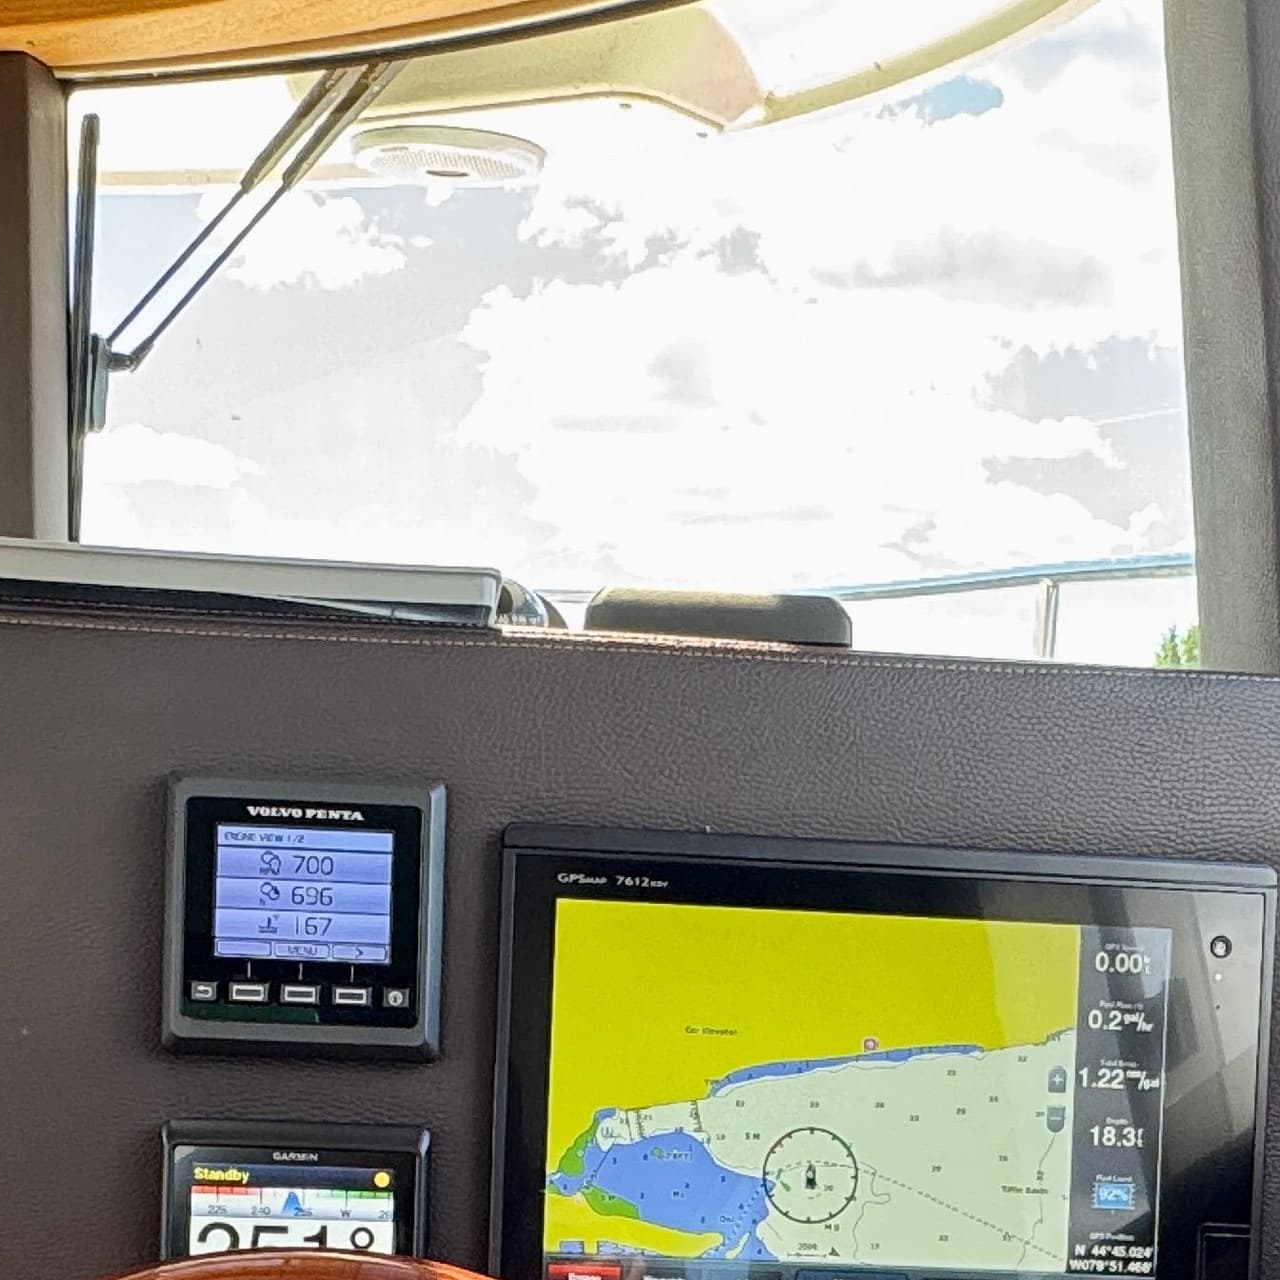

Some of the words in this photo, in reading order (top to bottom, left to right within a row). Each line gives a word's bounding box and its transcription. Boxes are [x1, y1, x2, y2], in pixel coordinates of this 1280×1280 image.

[247, 806, 303, 818] VOLVO
[305, 808, 365, 820] PENTA
[293, 855, 334, 875] 700
[291, 886, 334, 906] 696
[295, 915, 333, 937] 167
[1095, 951, 1143, 974] 0.00
[273, 1152, 318, 1162] GARMIN
[193, 1166, 250, 1185] Standby
[340, 1208, 351, 1218] W
[1074, 1244, 1087, 1257] N
